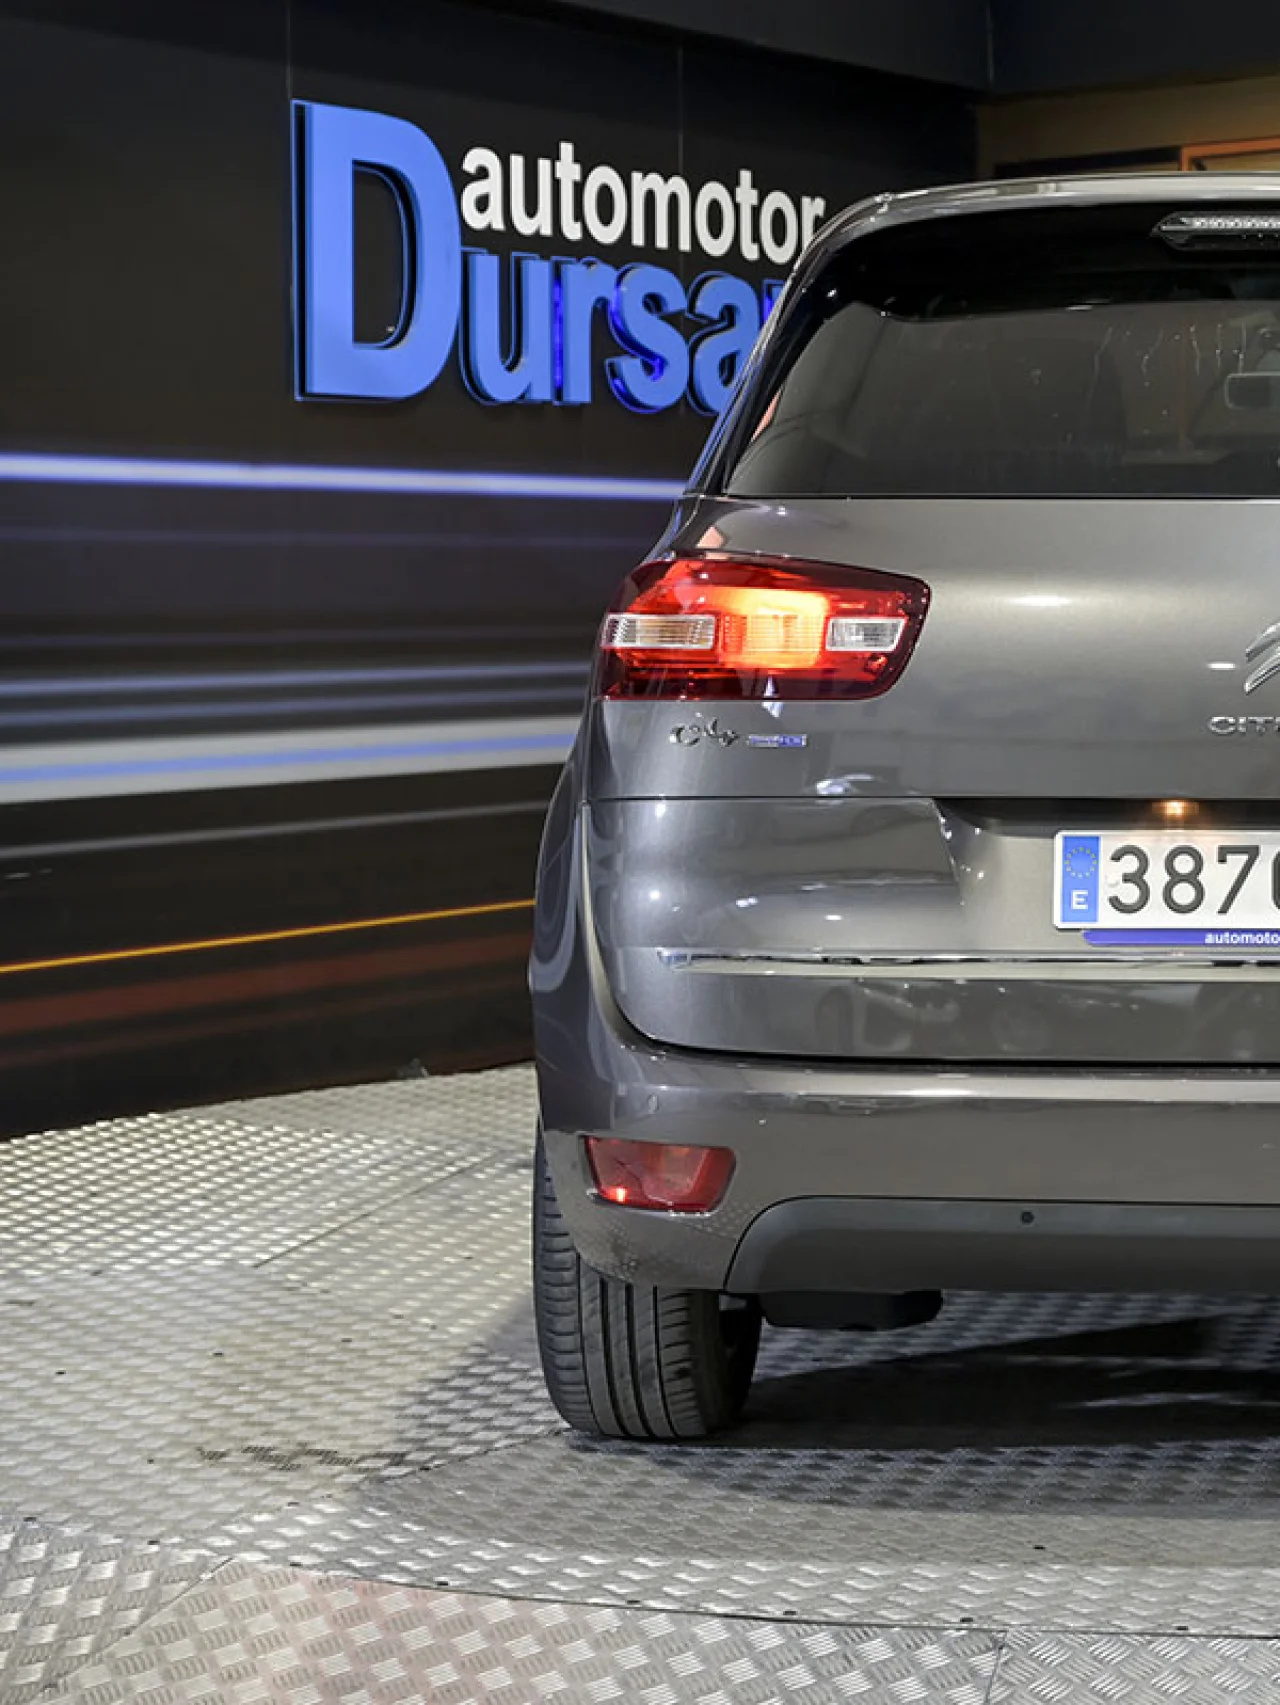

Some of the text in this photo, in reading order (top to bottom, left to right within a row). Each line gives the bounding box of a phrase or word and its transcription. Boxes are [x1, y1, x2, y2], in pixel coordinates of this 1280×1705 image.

[291, 98, 787, 416] Dursa
[461, 140, 825, 264] automotor
[1072, 891, 1088, 910] E
